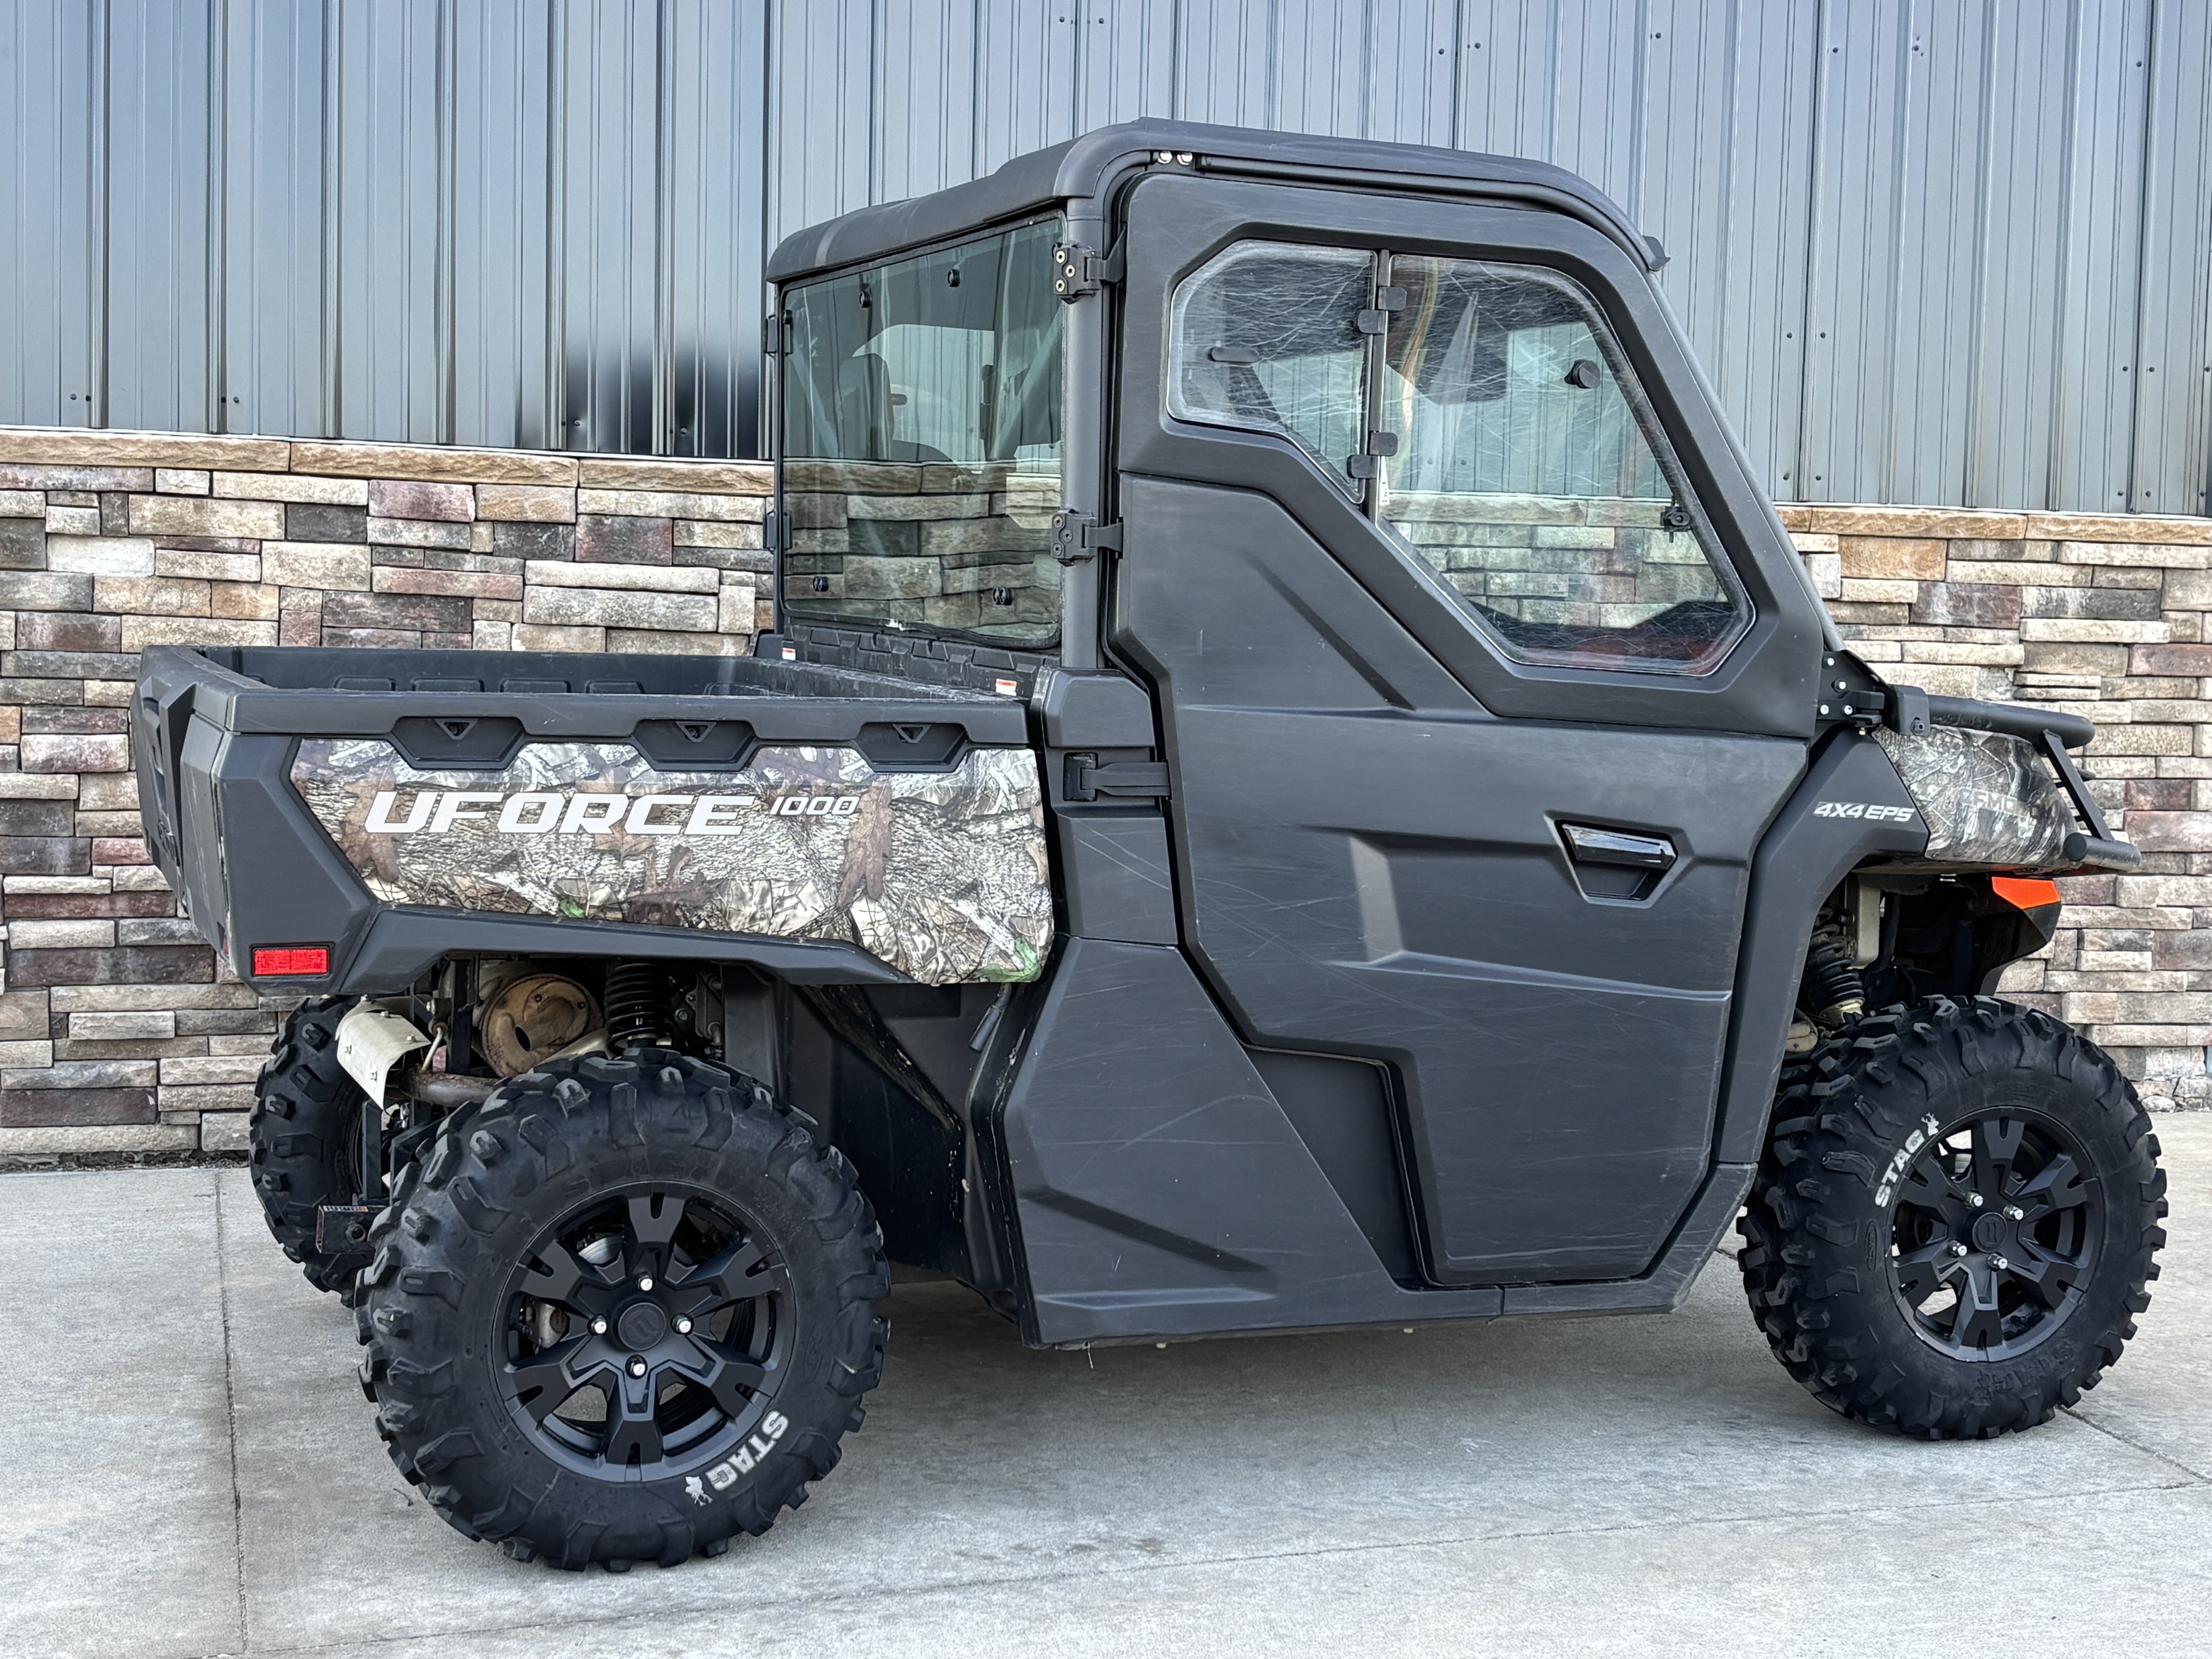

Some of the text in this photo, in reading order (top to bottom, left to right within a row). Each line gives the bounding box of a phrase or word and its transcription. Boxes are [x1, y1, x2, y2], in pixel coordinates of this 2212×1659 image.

[364, 791, 860, 835] UFORCE 1000
[1813, 802, 1915, 821] 4X4 EPS
[1875, 1129, 1925, 1207] STAG
[705, 1410, 788, 1491] STAG
